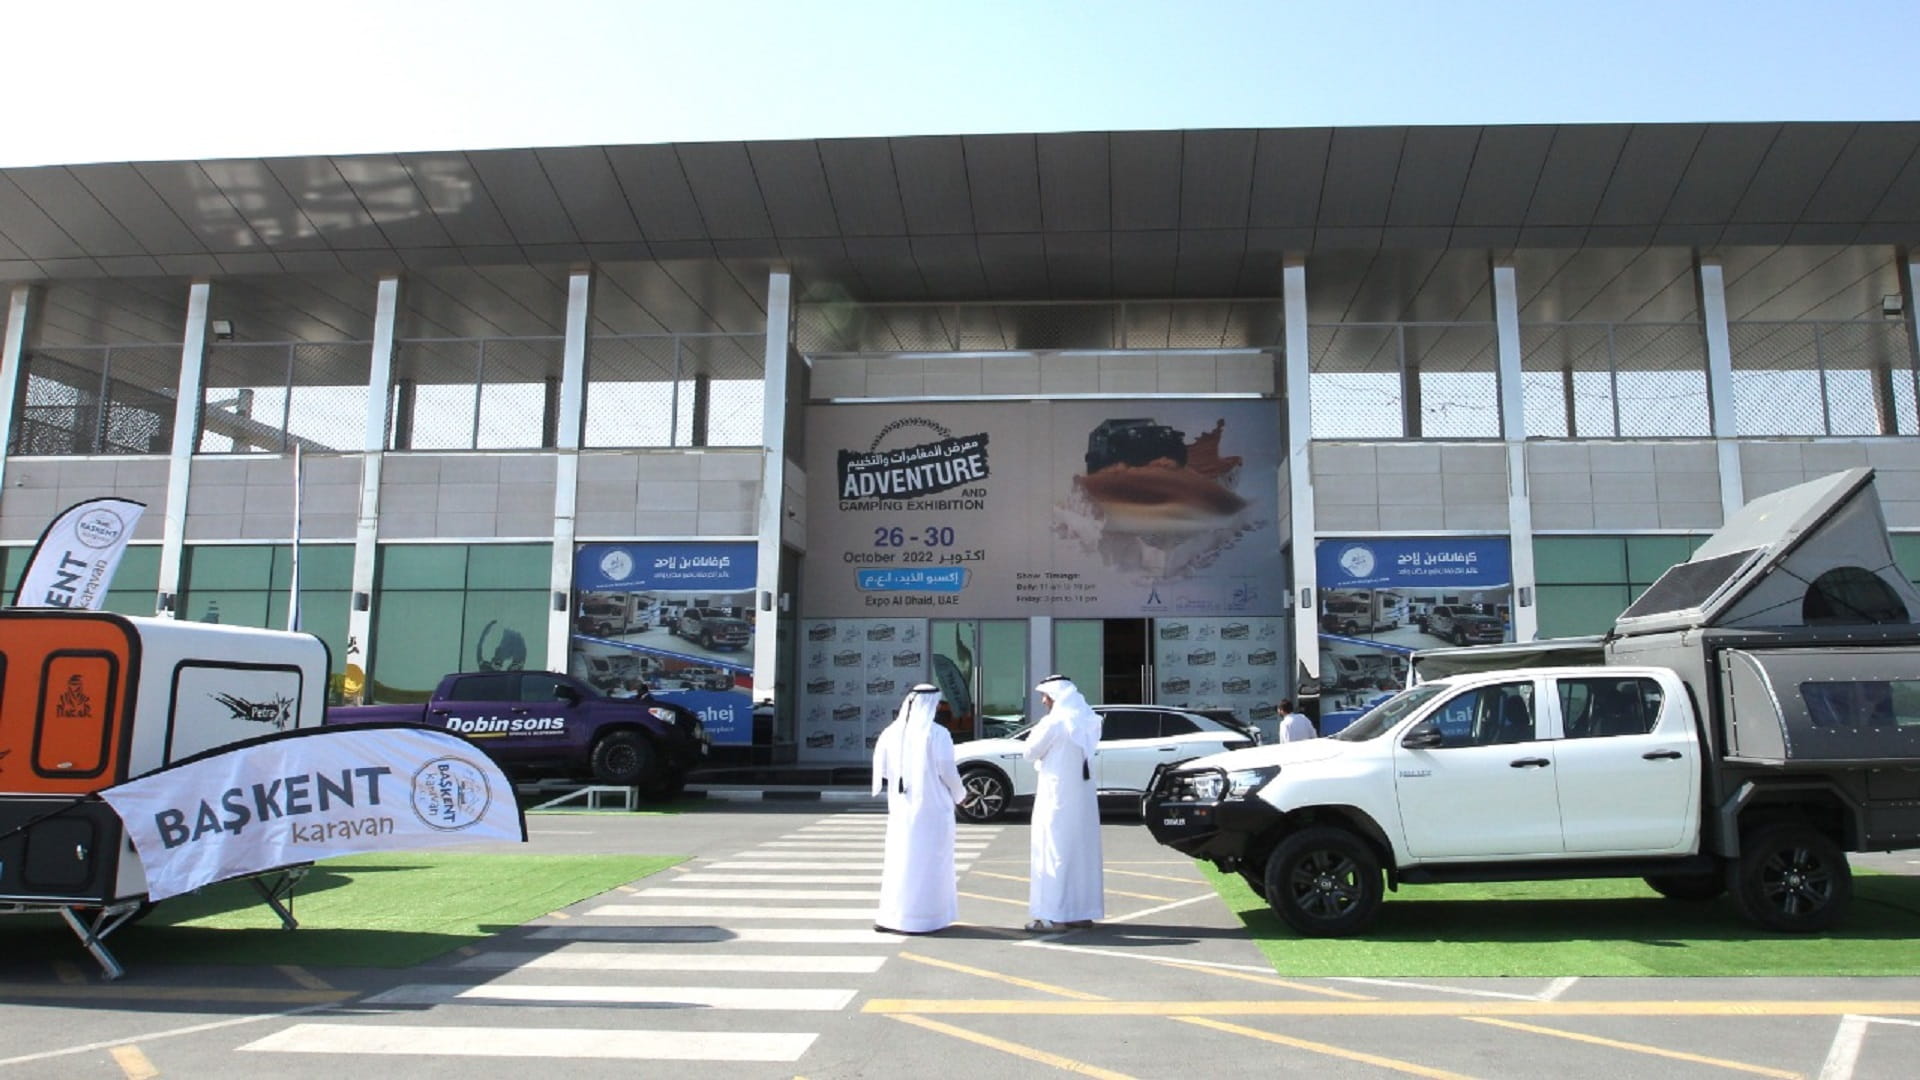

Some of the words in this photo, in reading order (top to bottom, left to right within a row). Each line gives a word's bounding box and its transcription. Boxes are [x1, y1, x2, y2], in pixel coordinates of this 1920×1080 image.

[890, 444, 942, 465] المغامرات
[944, 440, 979, 457] معرض
[847, 454, 889, 472] والتخييم
[843, 454, 985, 498] ADVENTURE
[961, 488, 987, 498] AND
[839, 500, 903, 511] CAMPING
[907, 500, 984, 511] EXHIBITION
[874, 526, 904, 548] 26
[924, 526, 955, 548] 30
[843, 551, 896, 563] October
[903, 551, 933, 563] 2022
[939, 549, 985, 564] اكتوبر
[926, 572, 959, 586] إكسبو
[865, 596, 890, 608] Expo
[892, 596, 903, 605] Al
[905, 596, 935, 606] Dhaid,
[938, 596, 960, 605] UAE
[697, 705, 734, 723] ahej
[446, 716, 564, 732] Dobinsons
[438, 764, 456, 823] BAŞKENT
[155, 766, 392, 849] BAŞKENT
[291, 815, 395, 844] karavan
